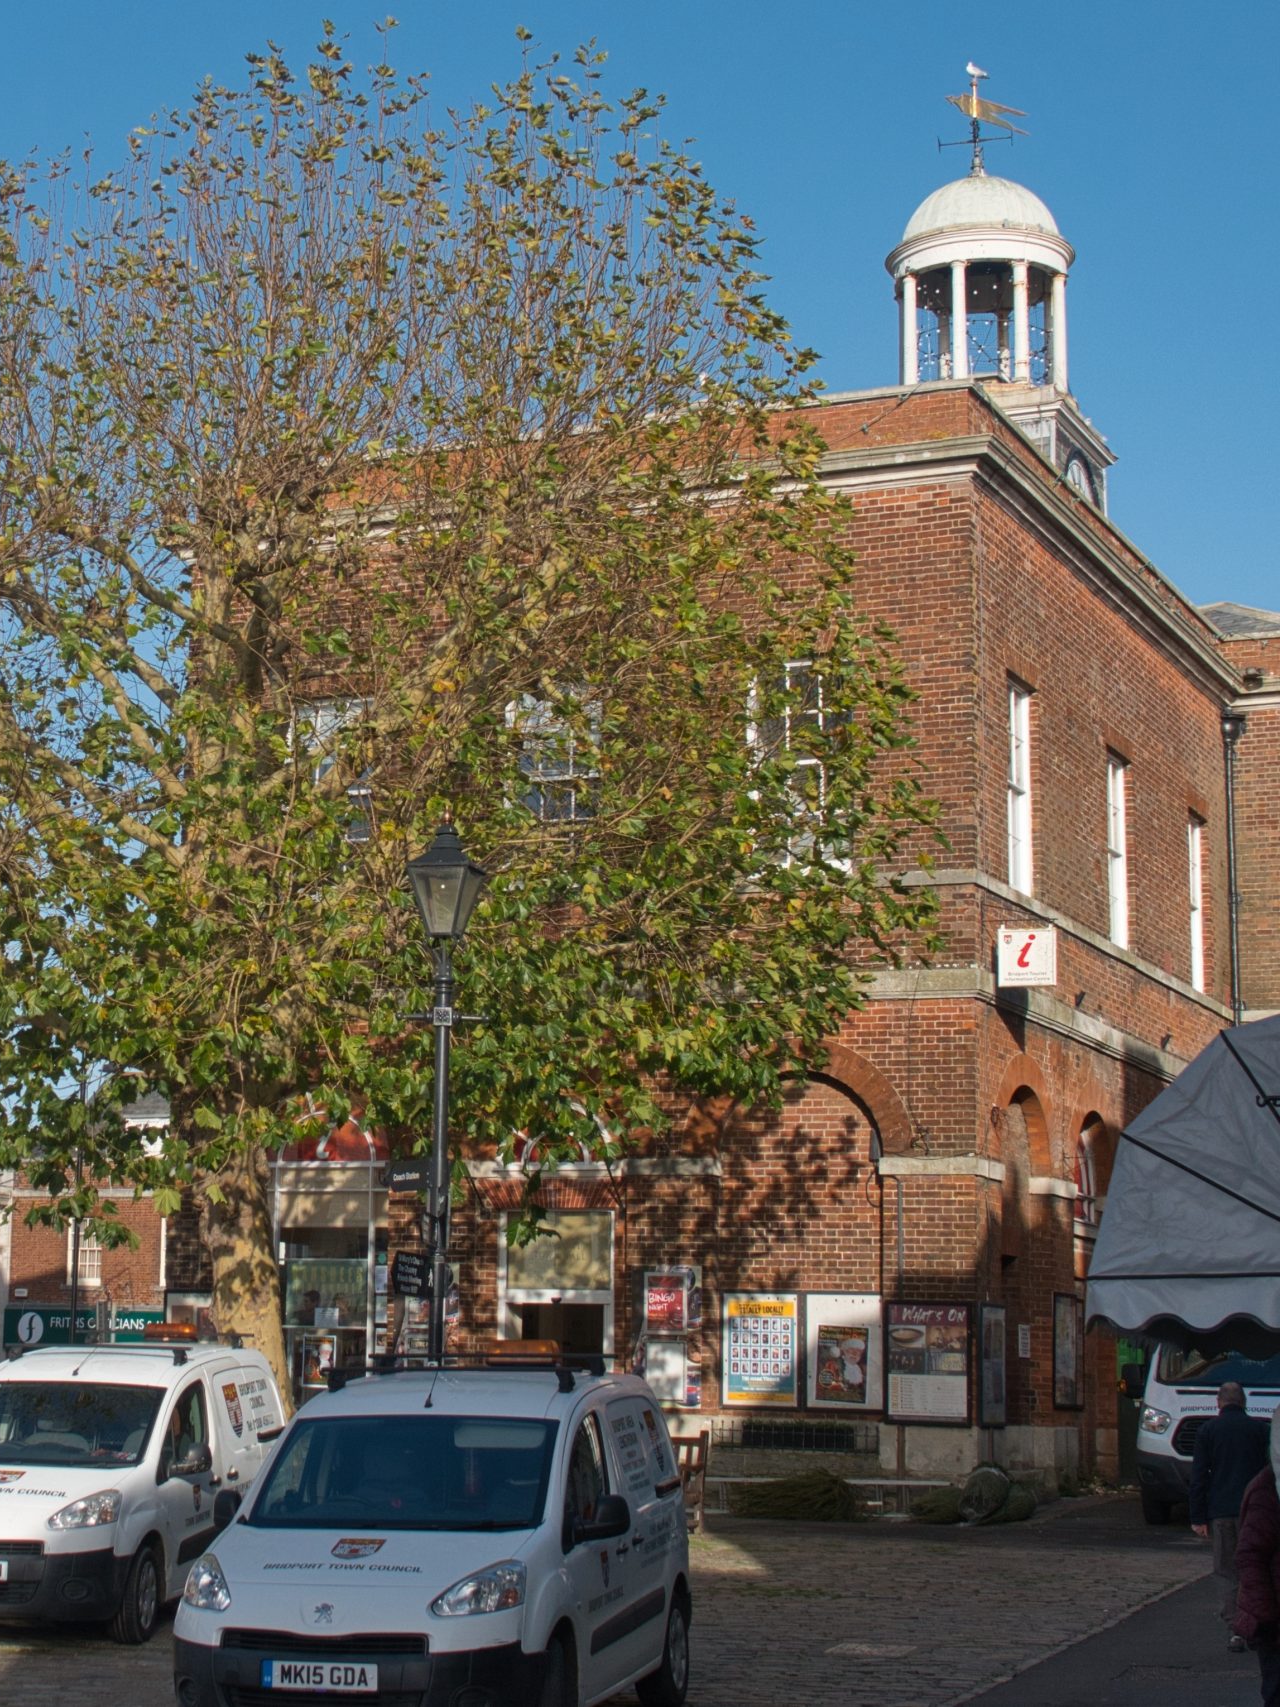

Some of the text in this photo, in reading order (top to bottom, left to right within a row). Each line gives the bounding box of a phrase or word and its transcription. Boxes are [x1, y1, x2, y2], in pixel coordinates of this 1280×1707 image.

[648, 1292, 676, 1304] BINGO
[648, 1303, 668, 1312] NIGHT
[902, 1306, 966, 1324] WHAT'S ON
[17, 1488, 68, 1498] COUNCIL
[263, 1562, 423, 1573] BRIDPORT TOWN COUNCIL
[280, 1664, 368, 1687] MK15 GDA
